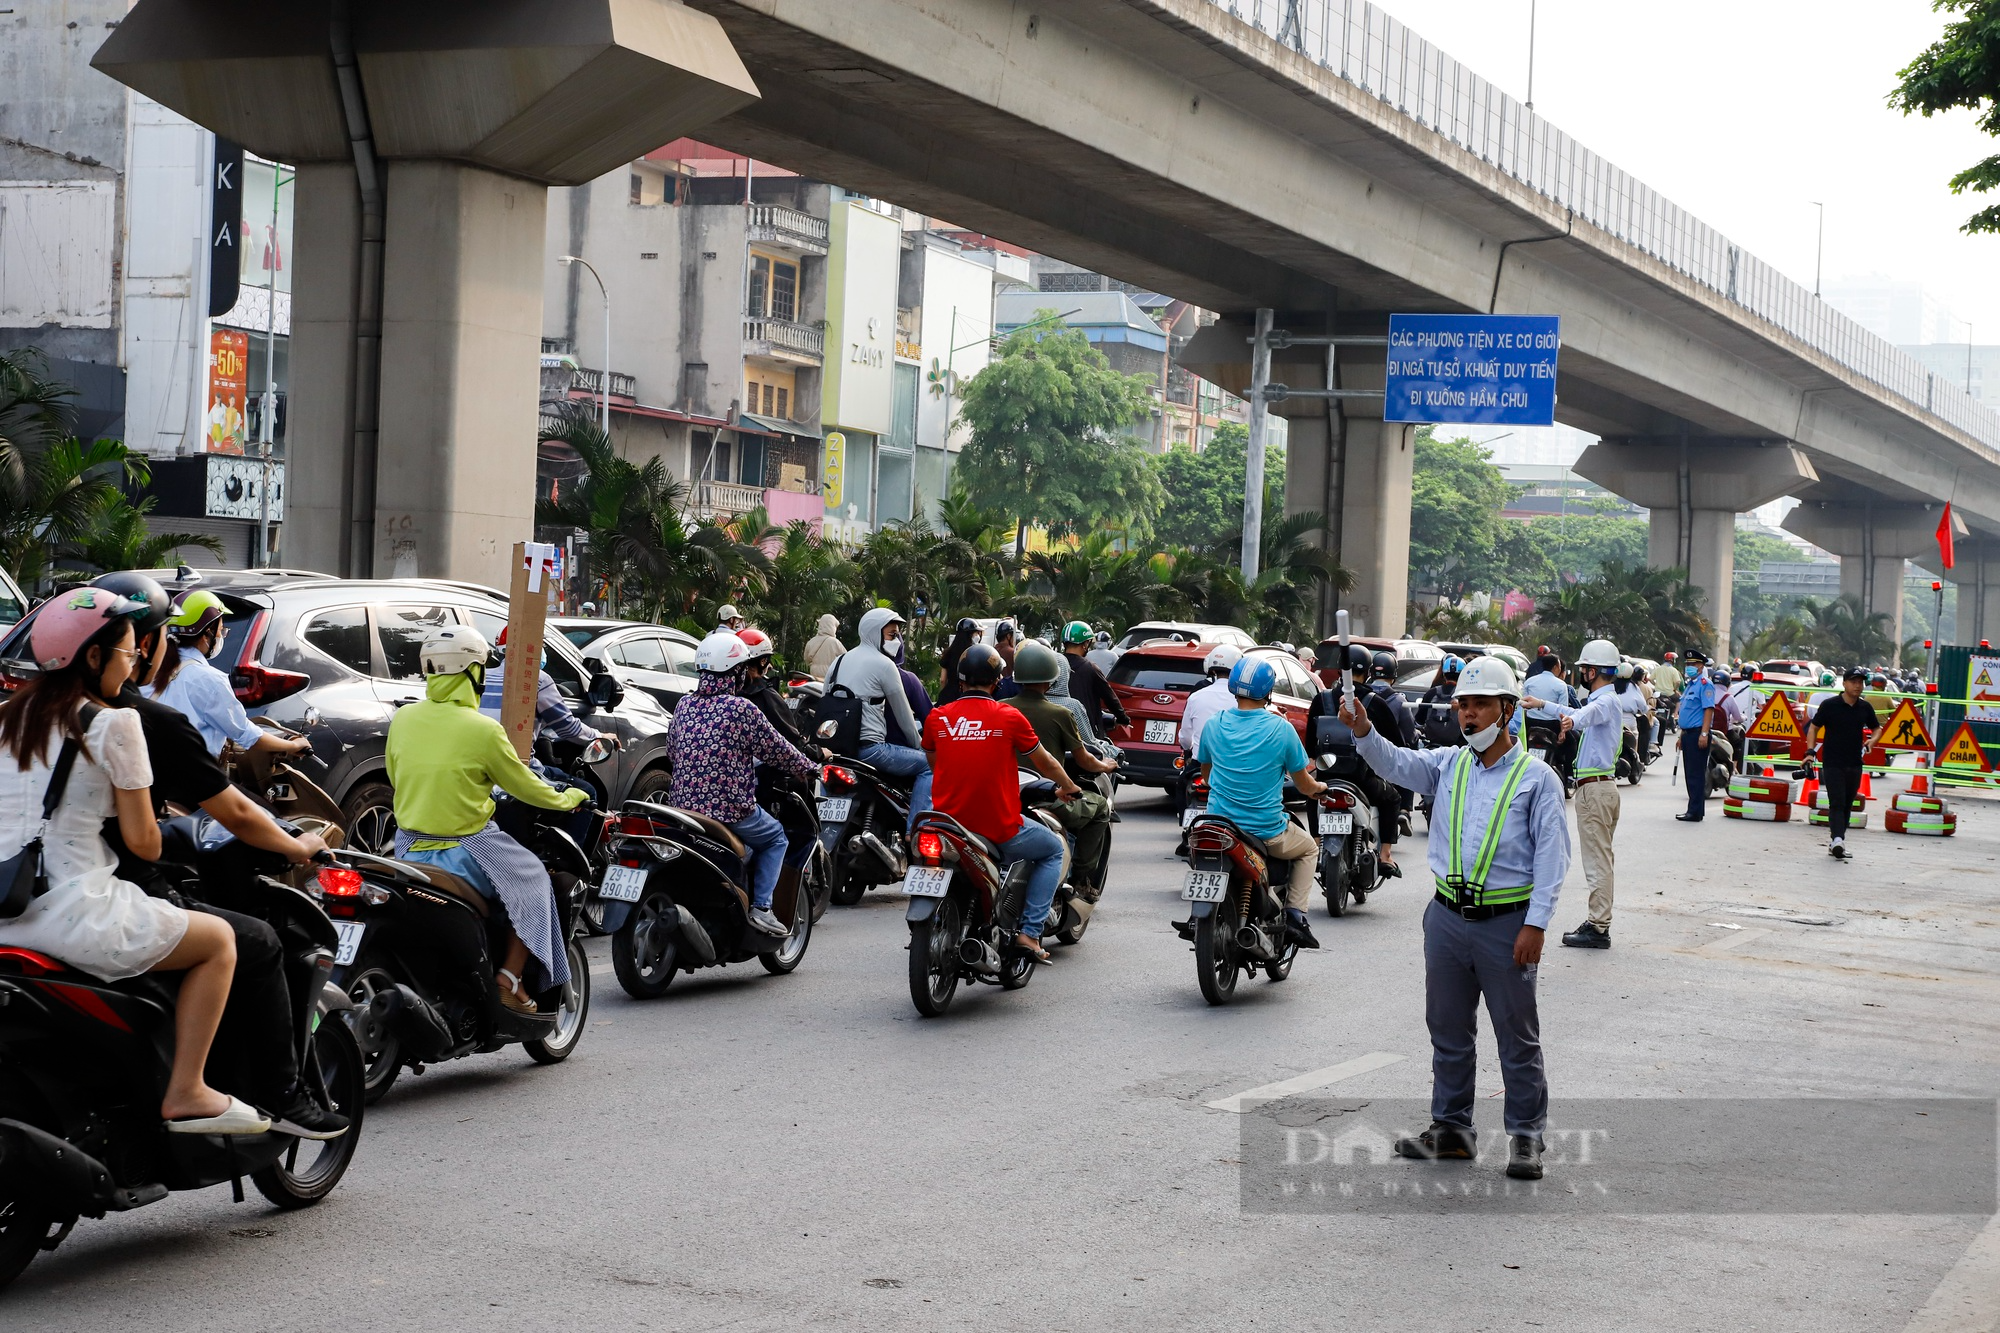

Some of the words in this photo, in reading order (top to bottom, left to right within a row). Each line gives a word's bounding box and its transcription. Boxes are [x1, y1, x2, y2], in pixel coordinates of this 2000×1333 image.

[1391, 328, 1414, 347] CÁC
[1417, 331, 1464, 348] PHƯƠNG
[1467, 329, 1494, 351] TIỆN
[1497, 333, 1513, 348] XE
[1516, 332, 1533, 349] CƠ
[1535, 330, 1557, 350] GIỚI
[852, 343, 885, 369] ZAMY
[1388, 361, 1400, 376] ĐI
[1402, 358, 1425, 377] NGÃ
[1427, 360, 1443, 377] TƯ
[1445, 356, 1461, 378] SỞ,
[1464, 357, 1501, 378] KHUẤT
[1504, 363, 1527, 378] DUY
[1530, 358, 1555, 379] TIẾN
[1410, 390, 1422, 406] ĐI
[1426, 386, 1465, 406] XUỐNG
[1469, 387, 1496, 408] HẦM
[1501, 392, 1528, 408] CHUI
[827, 438, 840, 503] ZAMY
[1772, 709, 1784, 720] ĐI
[1152, 721, 1169, 732] 30F
[1759, 720, 1793, 736] CHẬM
[1145, 730, 1174, 743] 597.73
[1959, 740, 1969, 750] ĐI
[1950, 751, 1977, 763] CHẬM
[1325, 815, 1347, 824] 18-H1
[1320, 824, 1350, 833] 510.59
[610, 867, 641, 884] 29-T1
[912, 868, 946, 882] 29-Z9
[1191, 873, 1222, 887] 33-R2
[602, 882, 640, 899] 390.66
[908, 880, 942, 894] 5959
[1188, 886, 1219, 900] 5297
